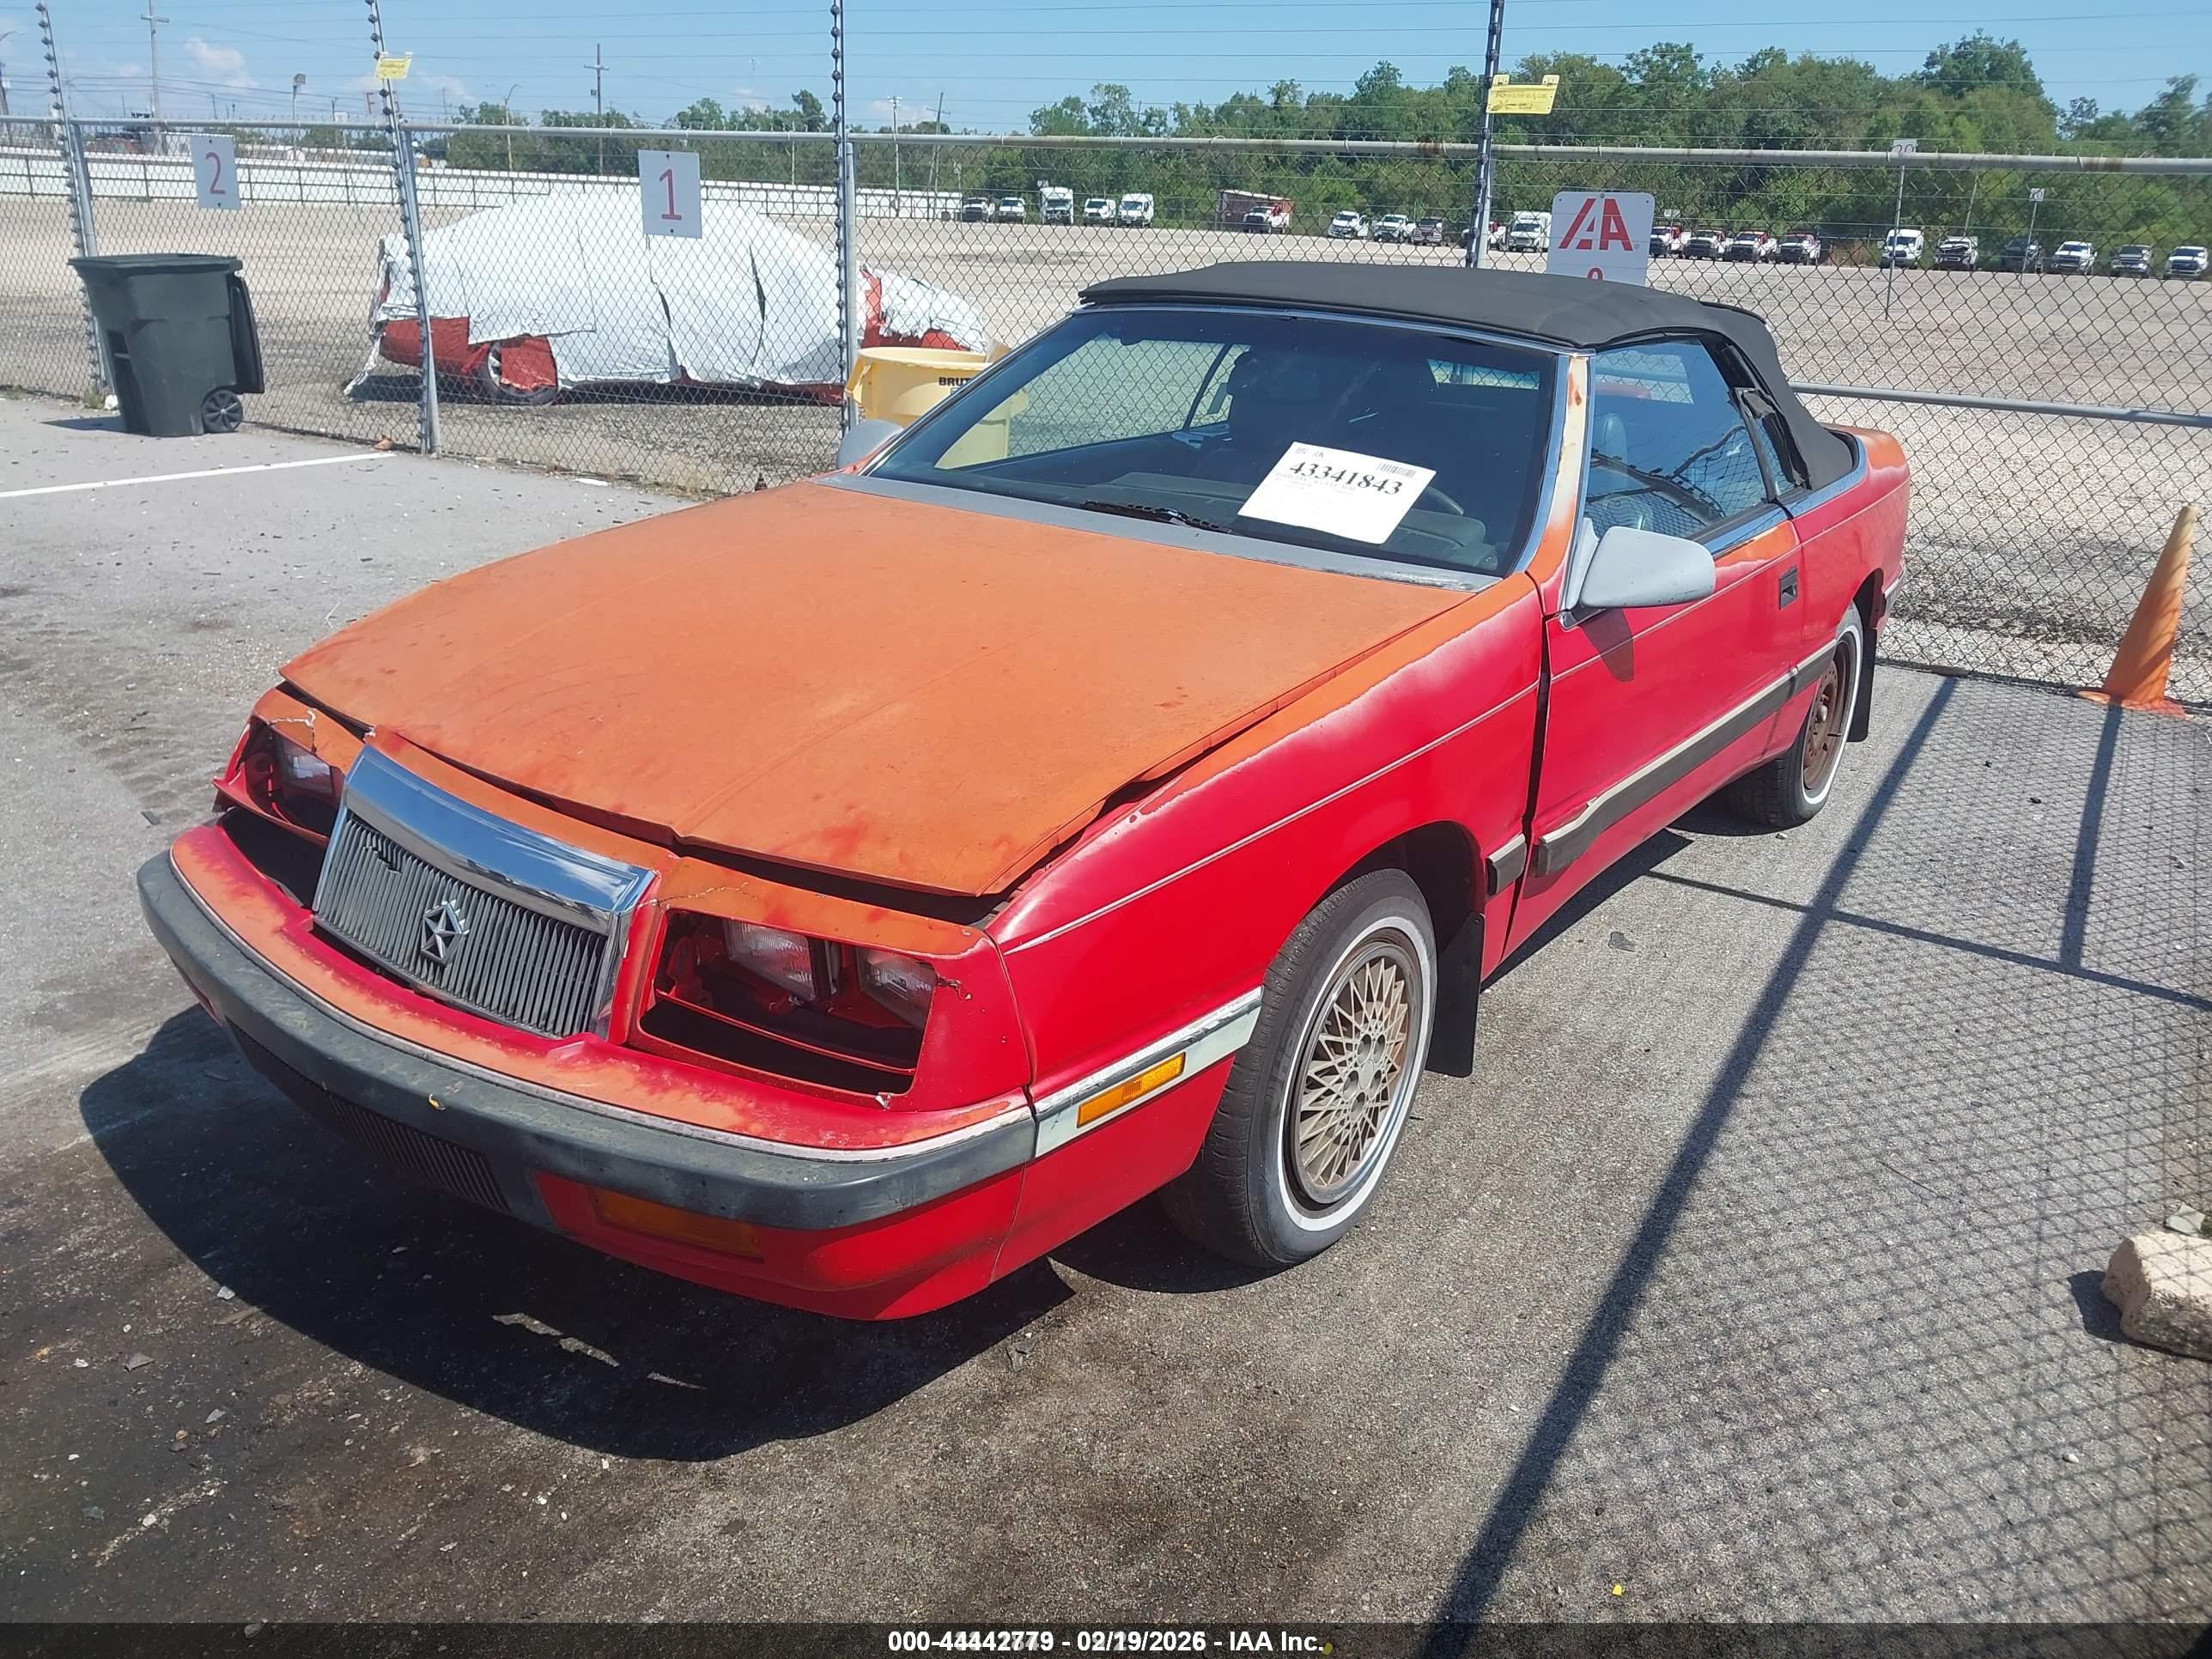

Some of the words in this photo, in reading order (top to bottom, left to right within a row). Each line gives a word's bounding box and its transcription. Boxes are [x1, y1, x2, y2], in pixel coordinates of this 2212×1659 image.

[205, 151, 226, 195] 2
[659, 168, 683, 221] 1
[1558, 198, 1634, 252] IAA
[1289, 460, 1404, 495] 43341843
